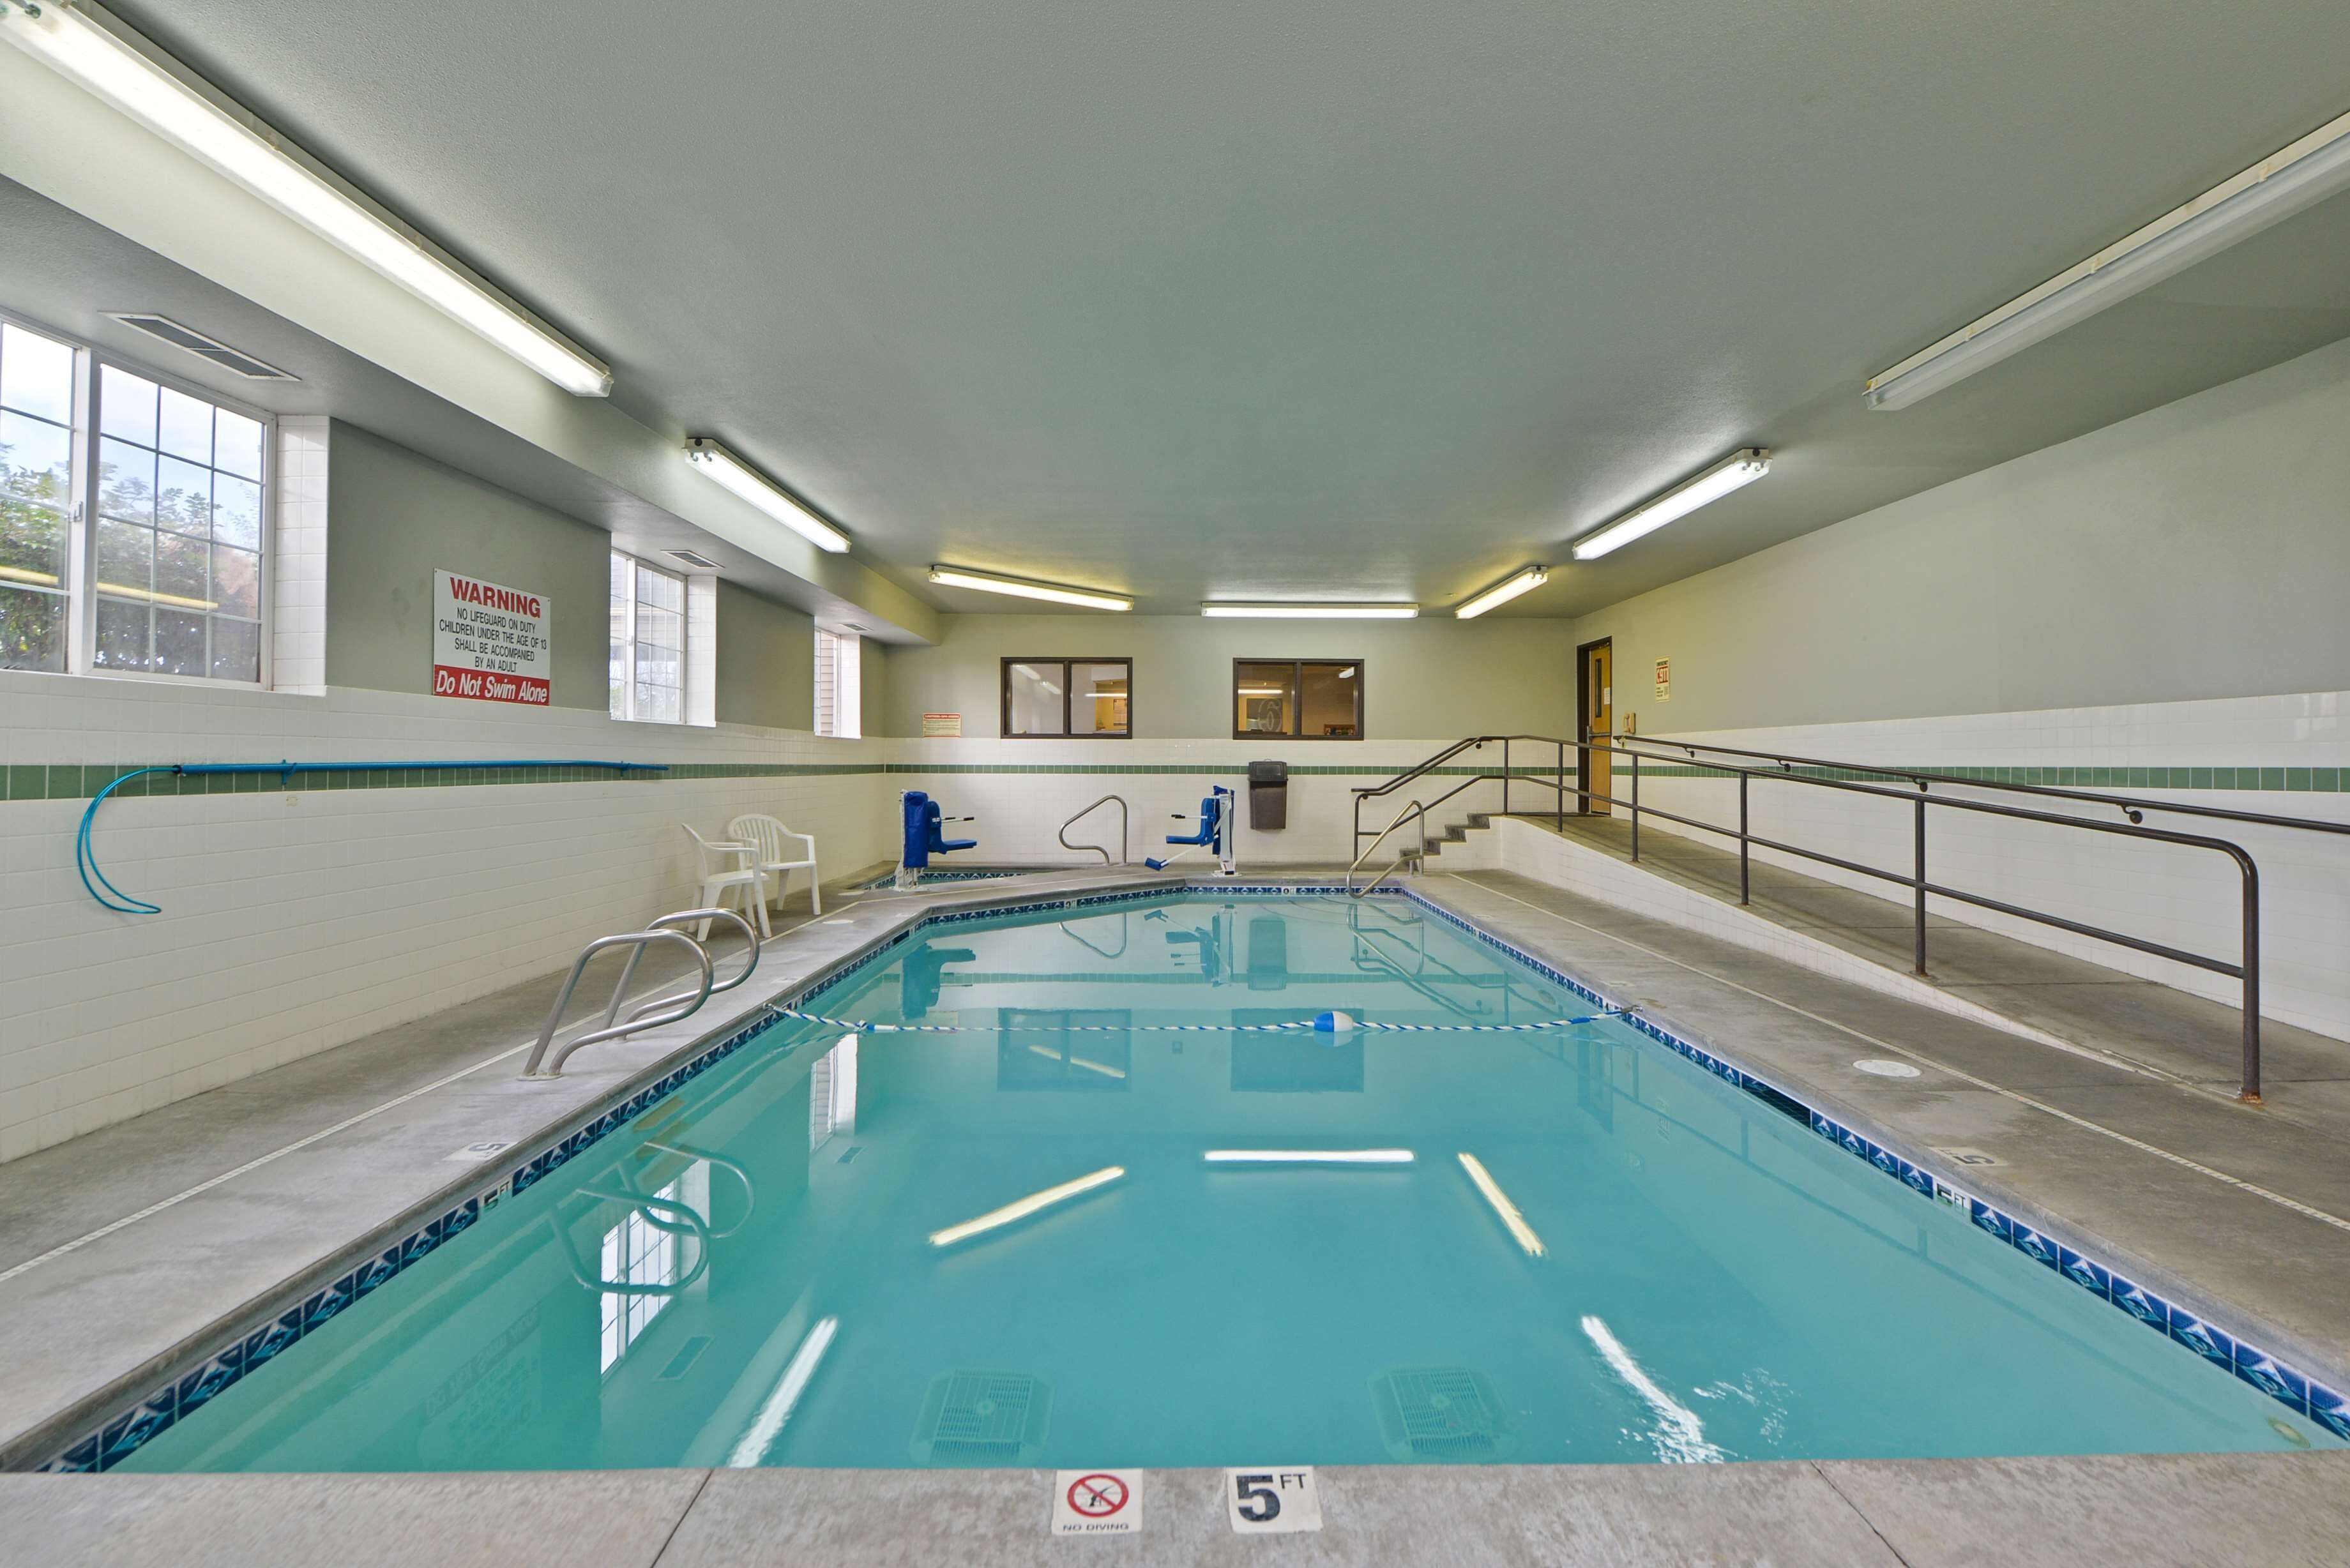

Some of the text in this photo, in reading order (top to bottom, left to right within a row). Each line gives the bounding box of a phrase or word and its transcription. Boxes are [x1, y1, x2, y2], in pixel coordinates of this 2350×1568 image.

[450, 577, 541, 618] WARNING
[457, 607, 536, 633] NO LIFEGUARD ON DUTY
[439, 619, 547, 650] CHILDREN UNDER THE AGE OF 13
[455, 638, 534, 661] SHALL BE ACCOMPANIED
[474, 656, 517, 672] BY AN ADULT
[436, 670, 547, 702] Do Not Swim Alone
[1954, 1192, 1966, 1207] FT
[1236, 1473, 1307, 1522] 5 FT
[1063, 1522, 1130, 1532] NO DIVING
